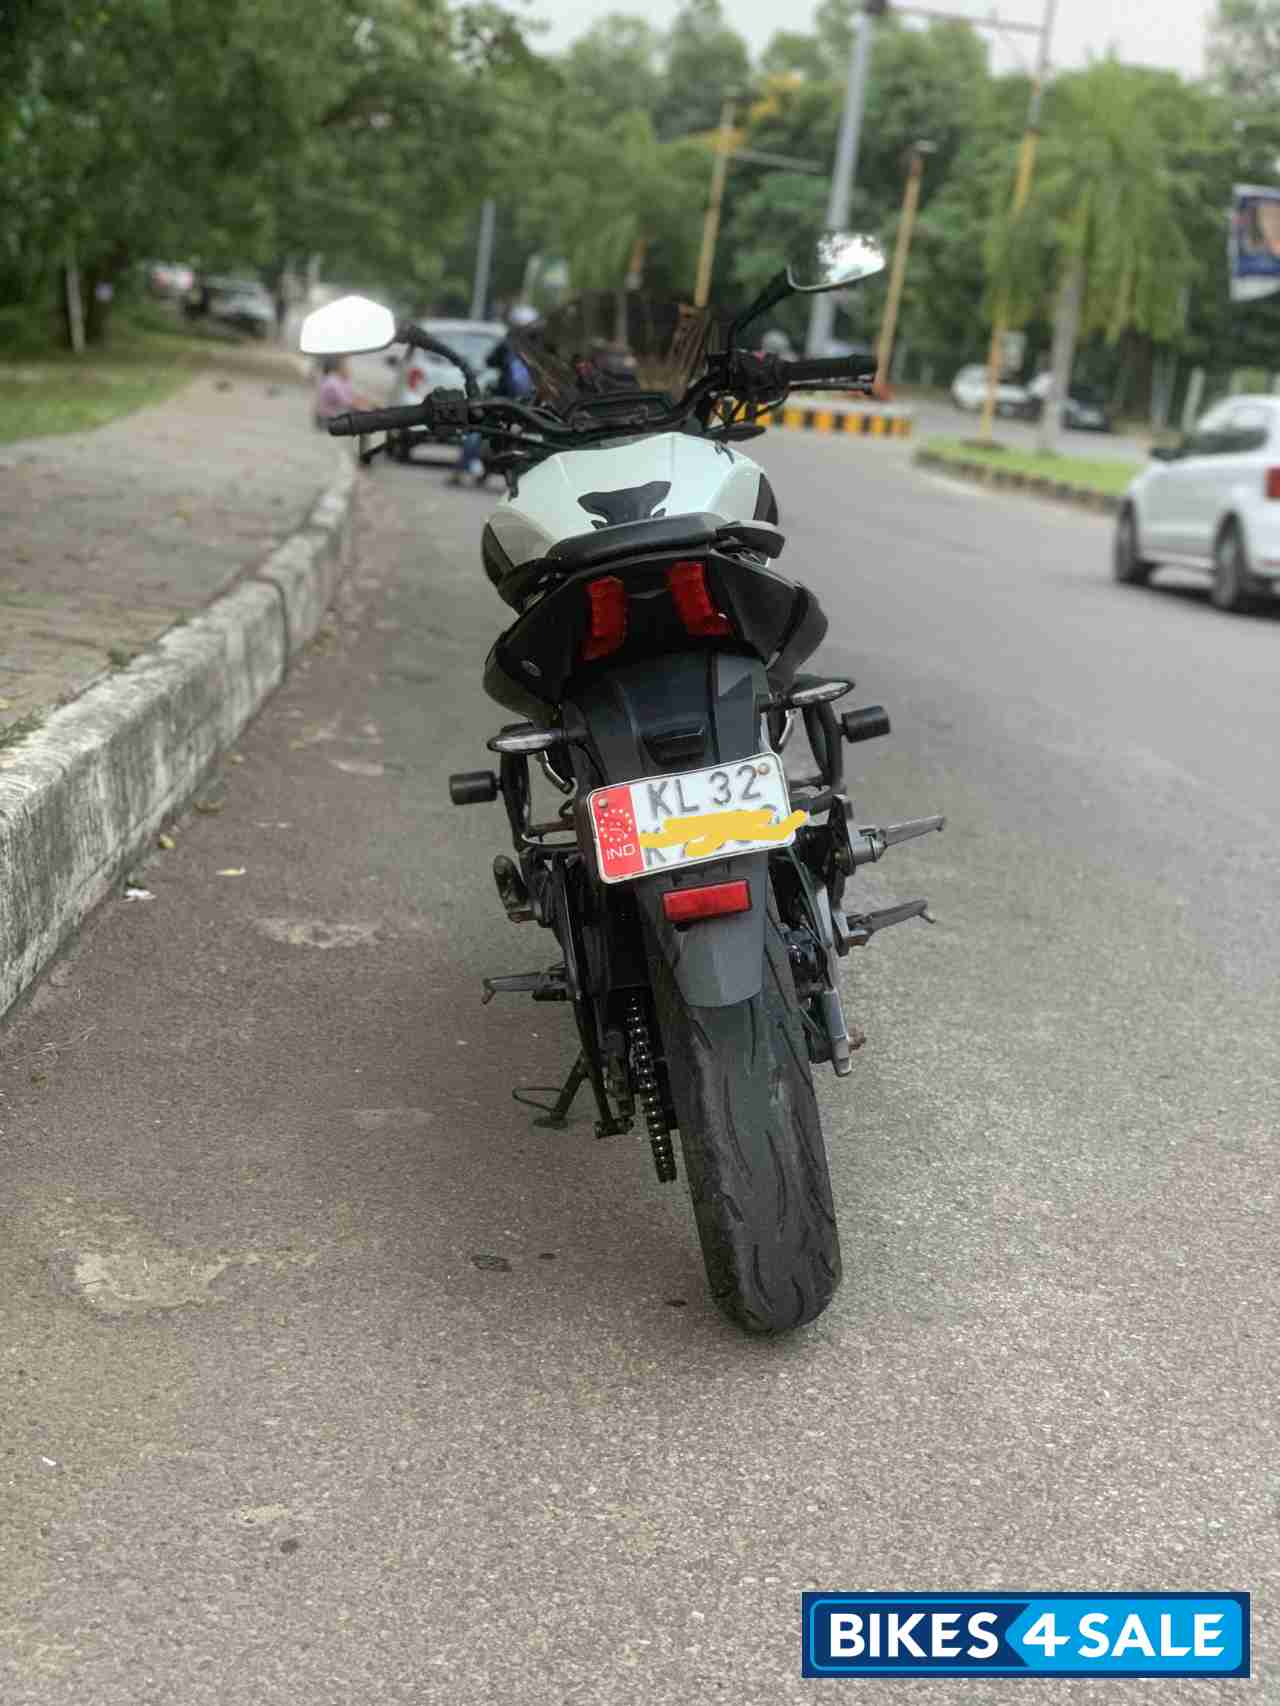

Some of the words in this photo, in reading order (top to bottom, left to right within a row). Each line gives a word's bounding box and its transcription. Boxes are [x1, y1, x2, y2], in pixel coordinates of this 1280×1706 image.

[648, 778, 699, 820] KL
[709, 765, 761, 805] 32
[606, 843, 636, 861] IND
